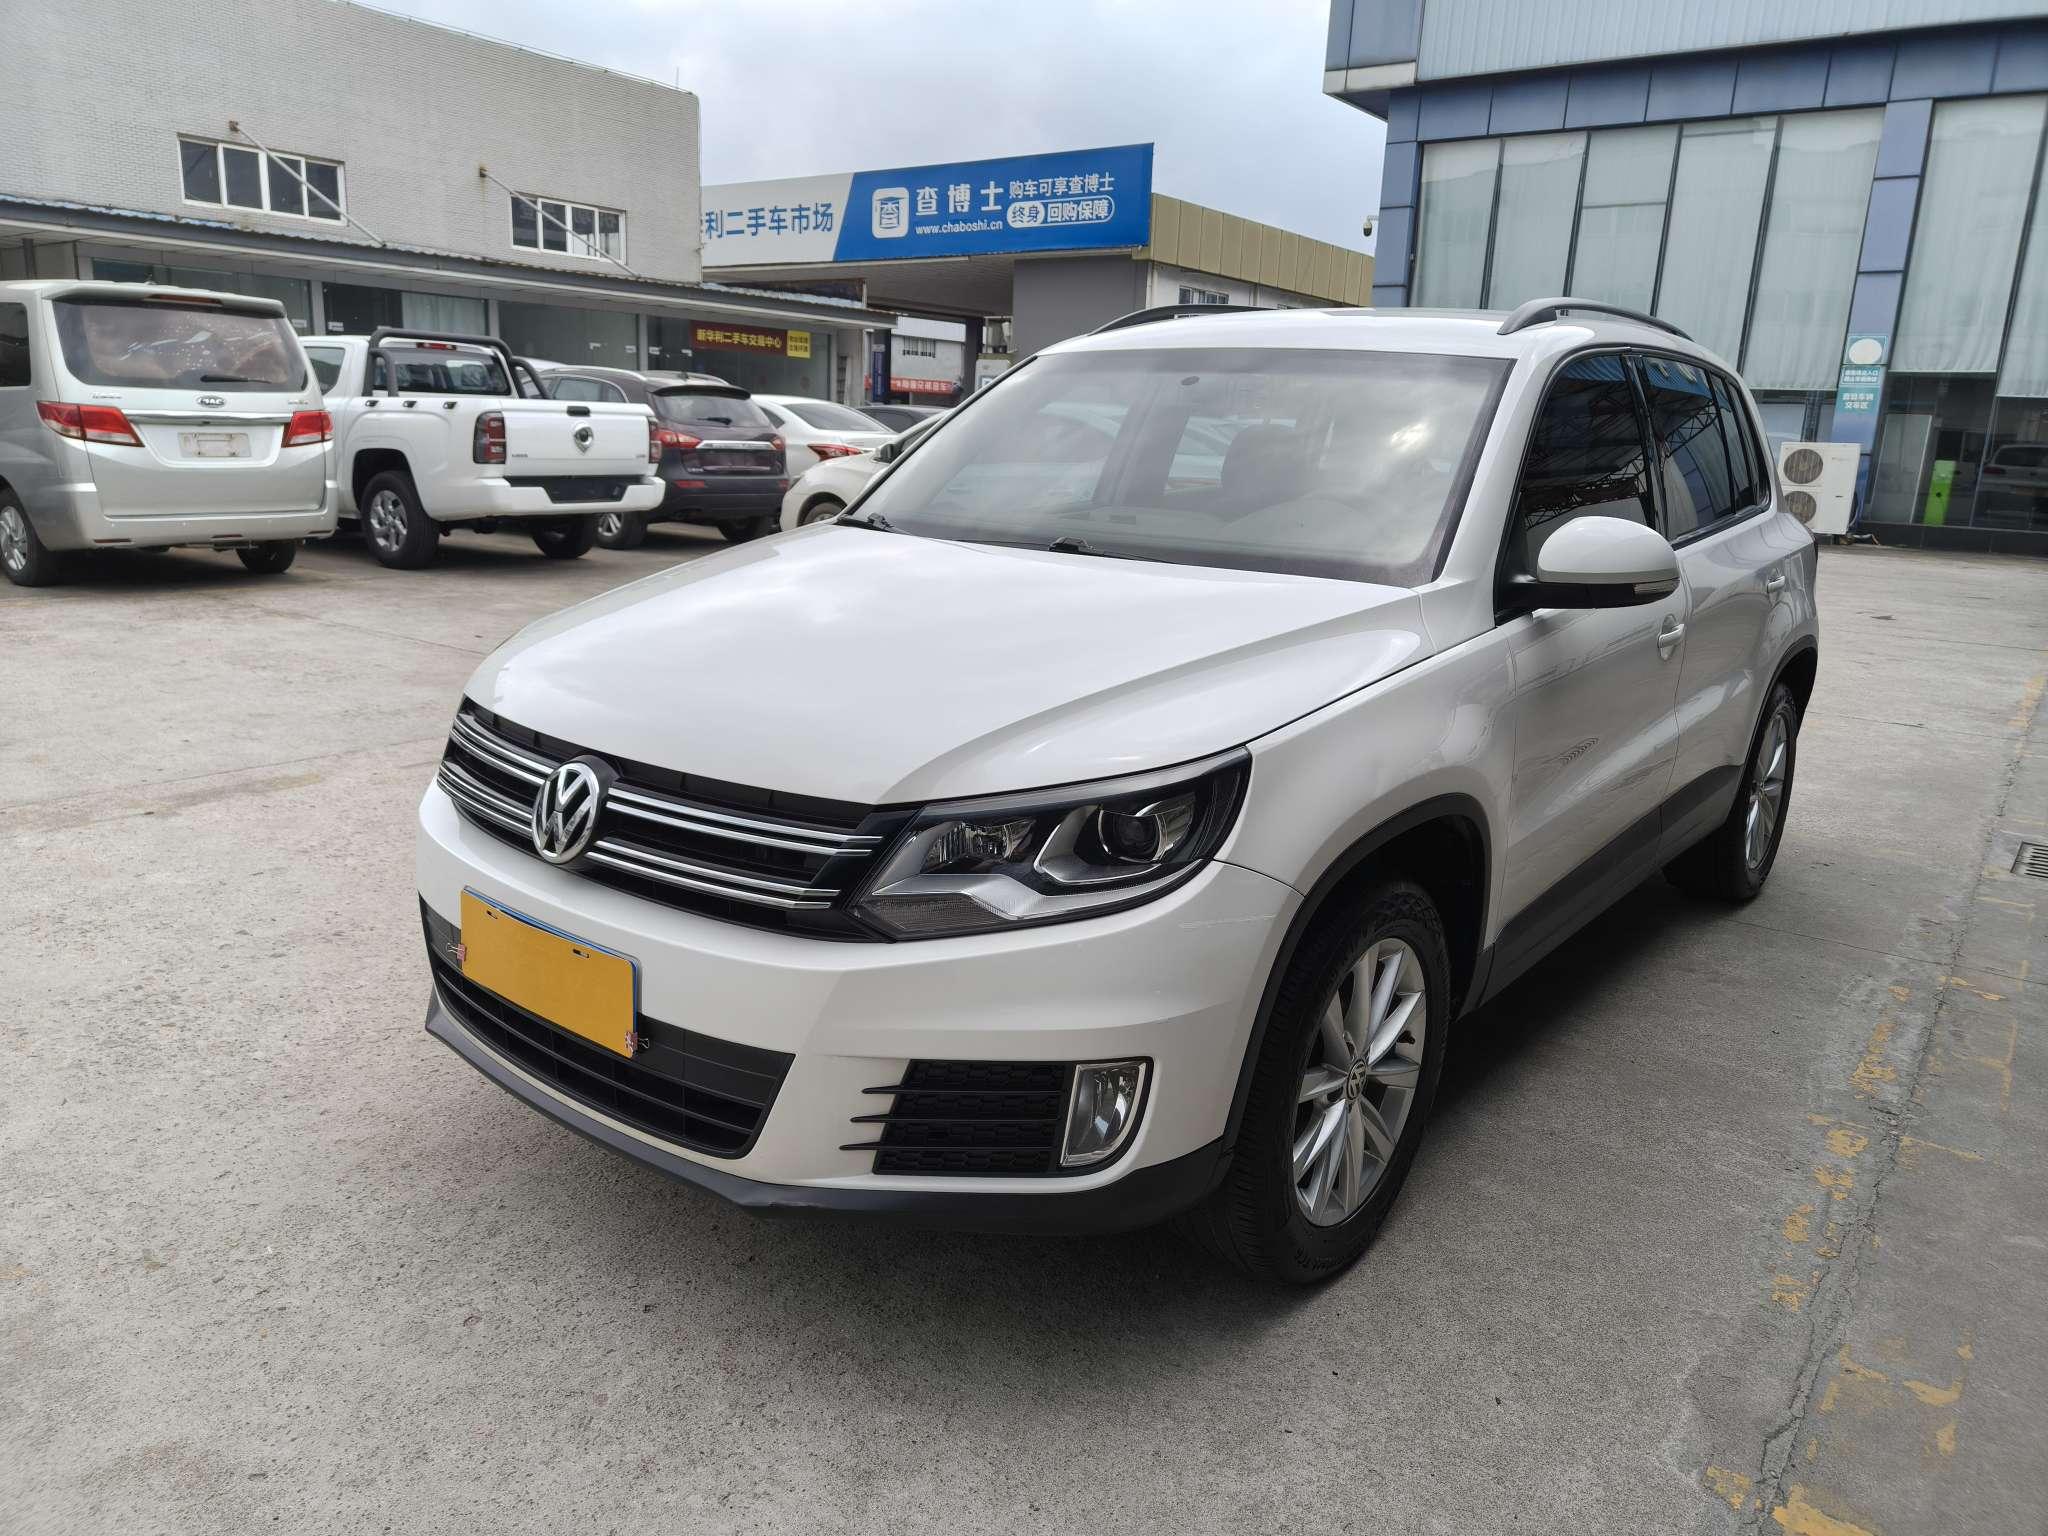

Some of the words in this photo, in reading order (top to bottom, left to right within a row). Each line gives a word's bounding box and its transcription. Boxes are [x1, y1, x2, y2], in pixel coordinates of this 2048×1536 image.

[915, 180, 1004, 216] 查博士
[1009, 172, 1114, 199] 购车可享查博士
[700, 202, 833, 240] 利二手车市场
[915, 219, 1003, 235] www.chaboshi.cn
